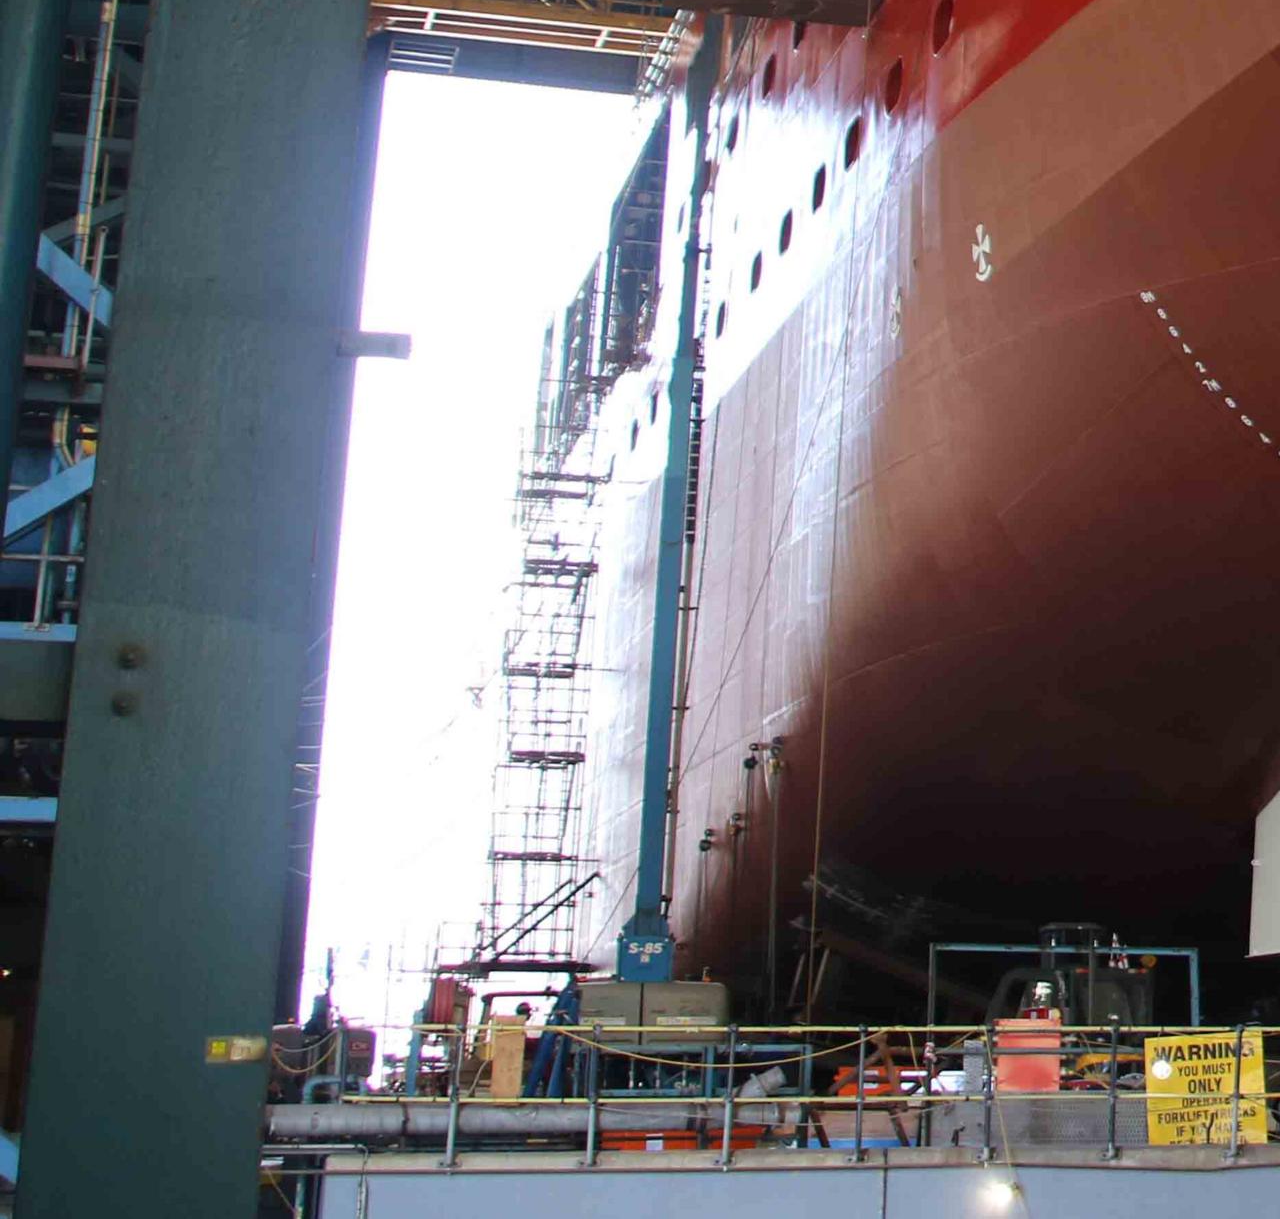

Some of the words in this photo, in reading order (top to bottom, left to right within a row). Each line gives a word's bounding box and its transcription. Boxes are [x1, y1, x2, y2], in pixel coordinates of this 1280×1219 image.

[1195, 361, 1206, 373] 2
[628, 942, 664, 954] S-85
[1154, 1040, 1255, 1062] WARNING
[1177, 1066, 1198, 1077] YOU
[1201, 1062, 1232, 1076] MUST
[1188, 1077, 1222, 1094] ONLY
[1158, 1109, 1209, 1124] FORKLIFT
